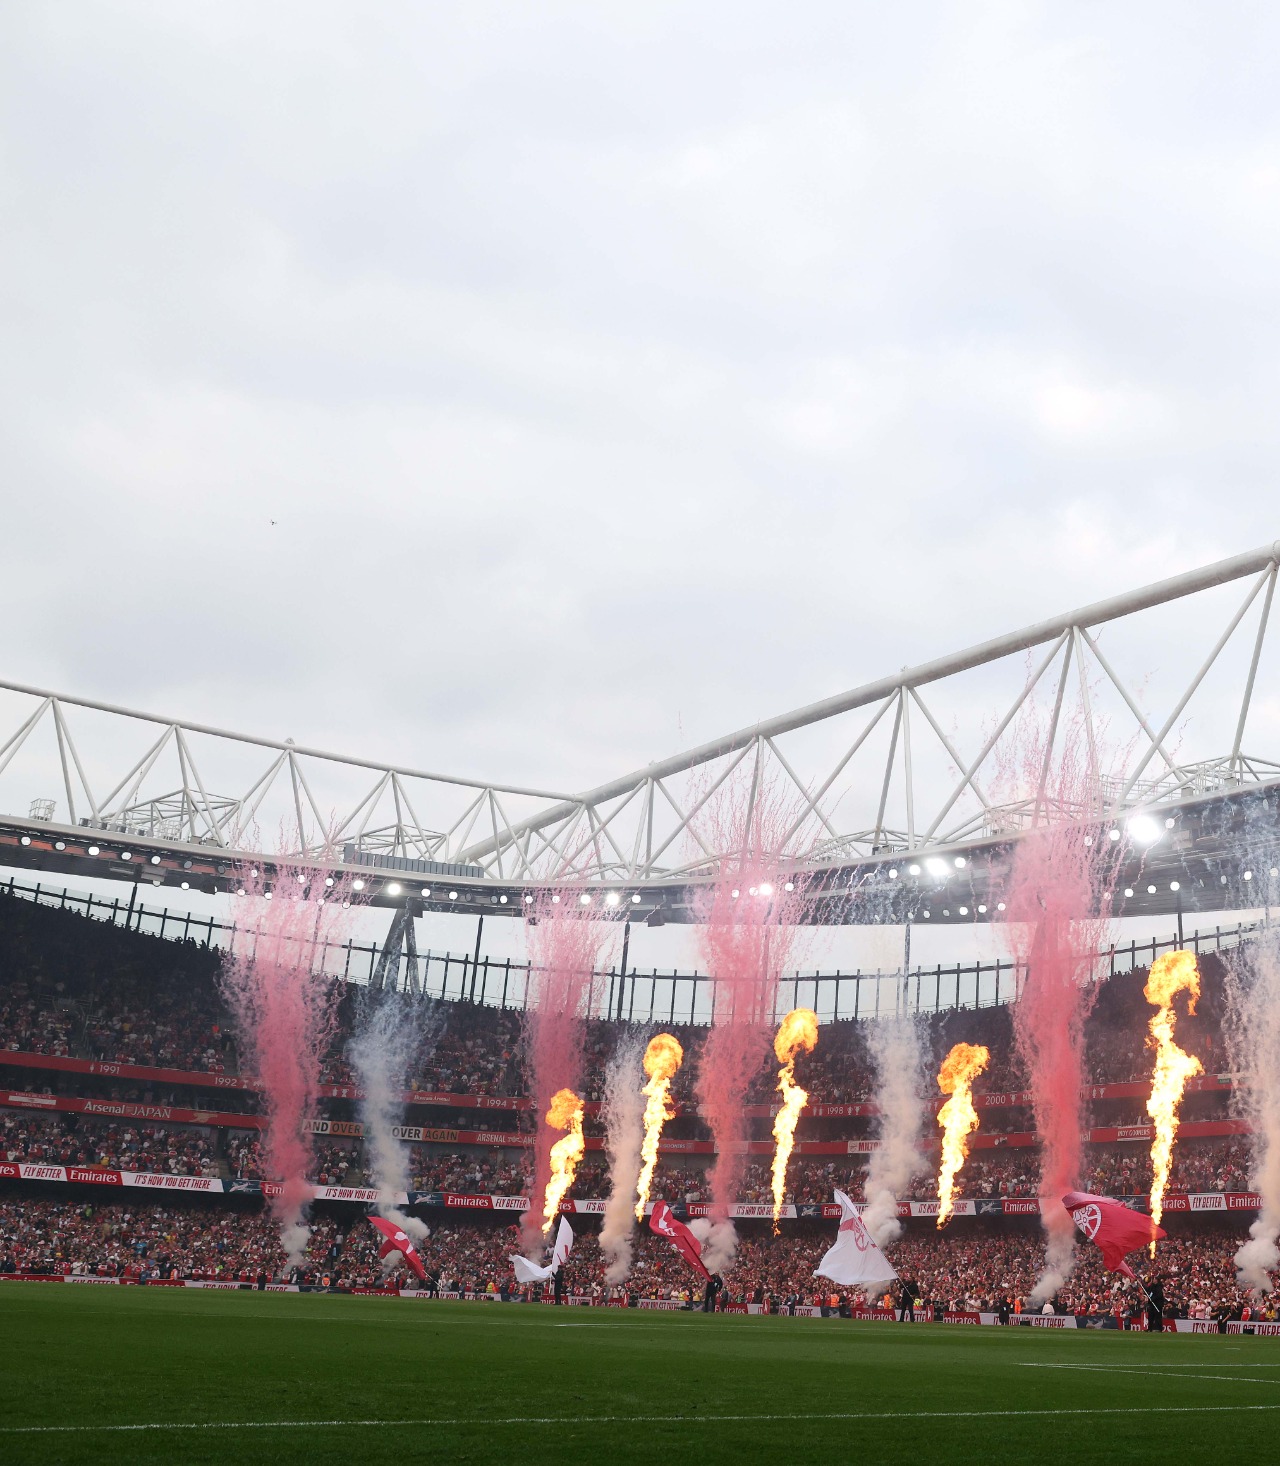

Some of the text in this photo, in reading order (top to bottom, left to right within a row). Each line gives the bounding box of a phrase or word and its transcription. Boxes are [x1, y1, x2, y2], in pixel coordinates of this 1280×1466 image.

[100, 1064, 120, 1075] 1991
[214, 1077, 238, 1087] 1992
[486, 1098, 507, 1108] 1994
[985, 1095, 1006, 1106] 2000
[84, 1100, 171, 1119] Arsenal JAPAN
[827, 1106, 844, 1115] 1998
[303, 1120, 329, 1133] AND
[332, 1123, 361, 1135] OVER
[391, 1126, 458, 1141] OVER AGAIN
[23, 1166, 63, 1180] FLY BETTER
[70, 1170, 118, 1183] Emirates
[134, 1174, 211, 1190] IT'S HOW YOU GET THERE
[325, 1188, 337, 1197] IT'S
[337, 1189, 354, 1198] HOW
[354, 1189, 366, 1199] YOU
[447, 1195, 489, 1207] Emirates
[495, 1198, 527, 1209] FLY BETTER
[1193, 1197, 1223, 1208] FLY BETTER
[1004, 1201, 1037, 1213] Emirates
